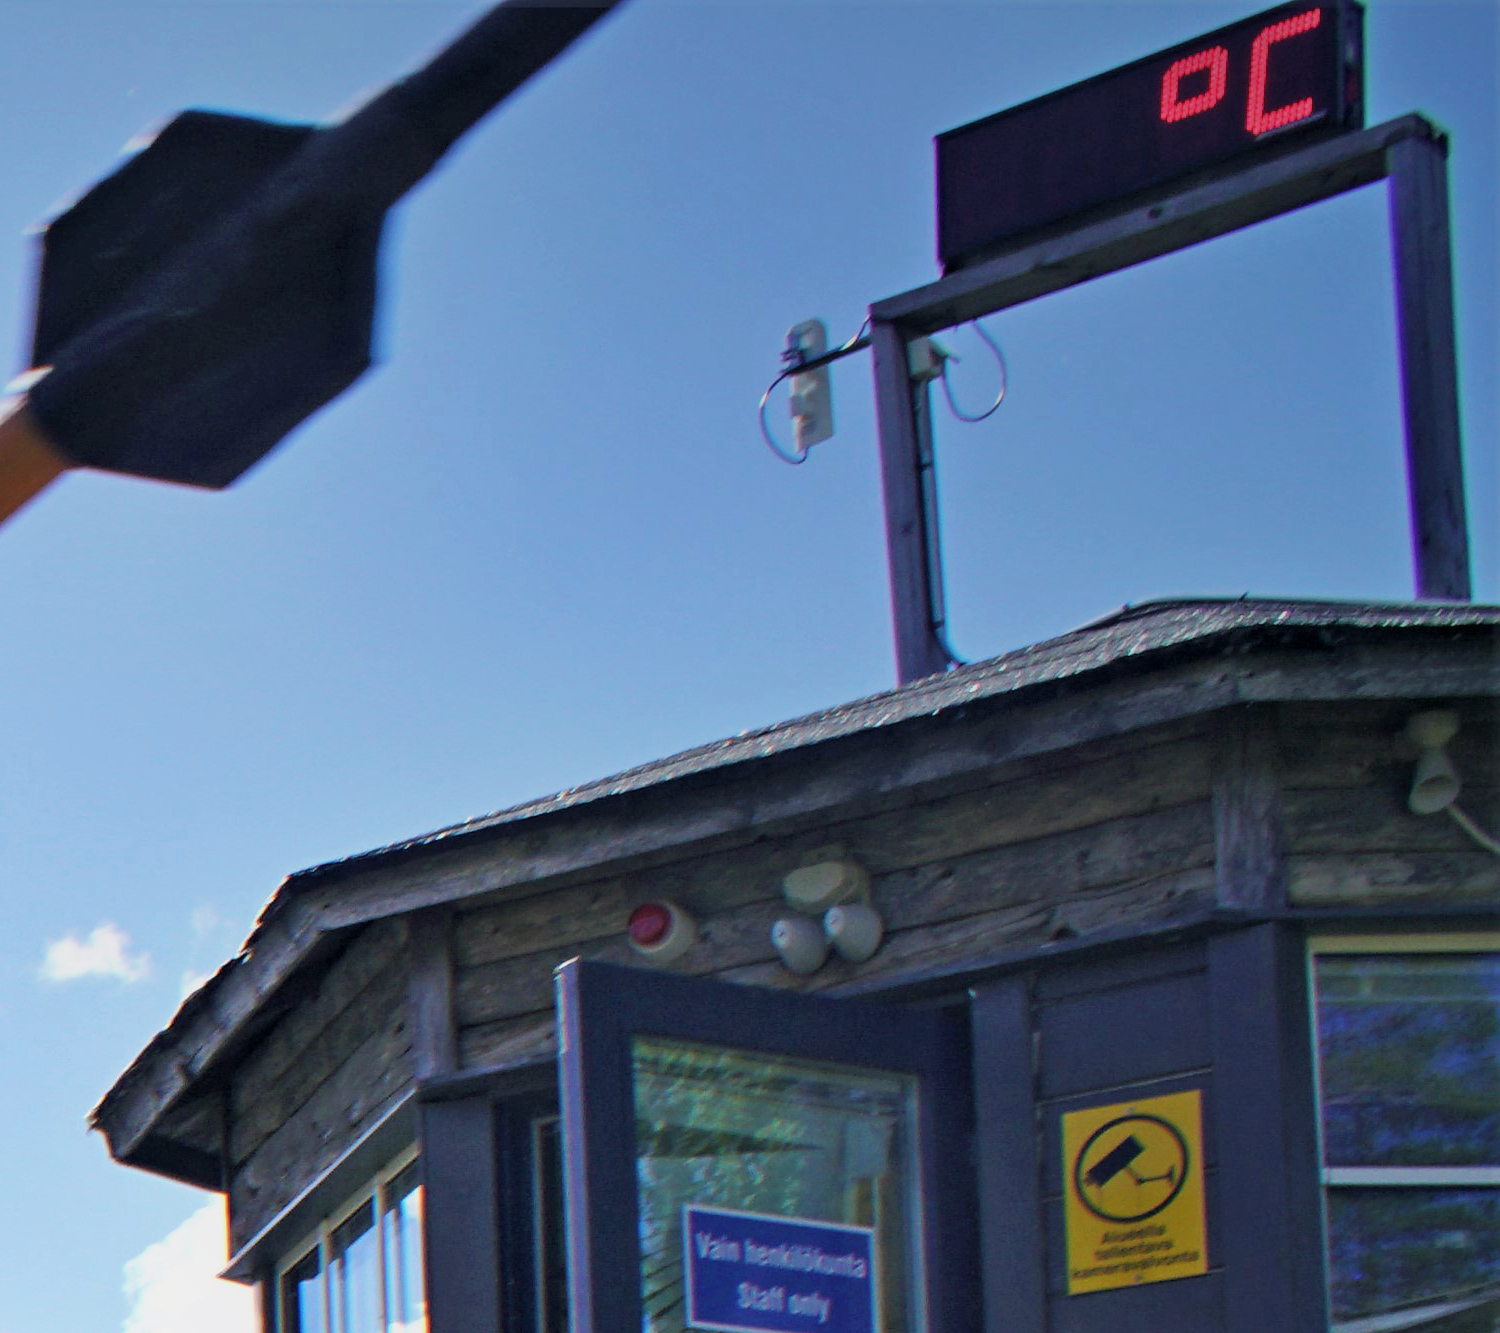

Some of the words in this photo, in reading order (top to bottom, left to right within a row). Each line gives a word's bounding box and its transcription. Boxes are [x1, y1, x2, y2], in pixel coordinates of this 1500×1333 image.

[696, 1231, 741, 1263] Vain
[737, 1281, 785, 1312] Staff
[788, 1292, 830, 1324] only
